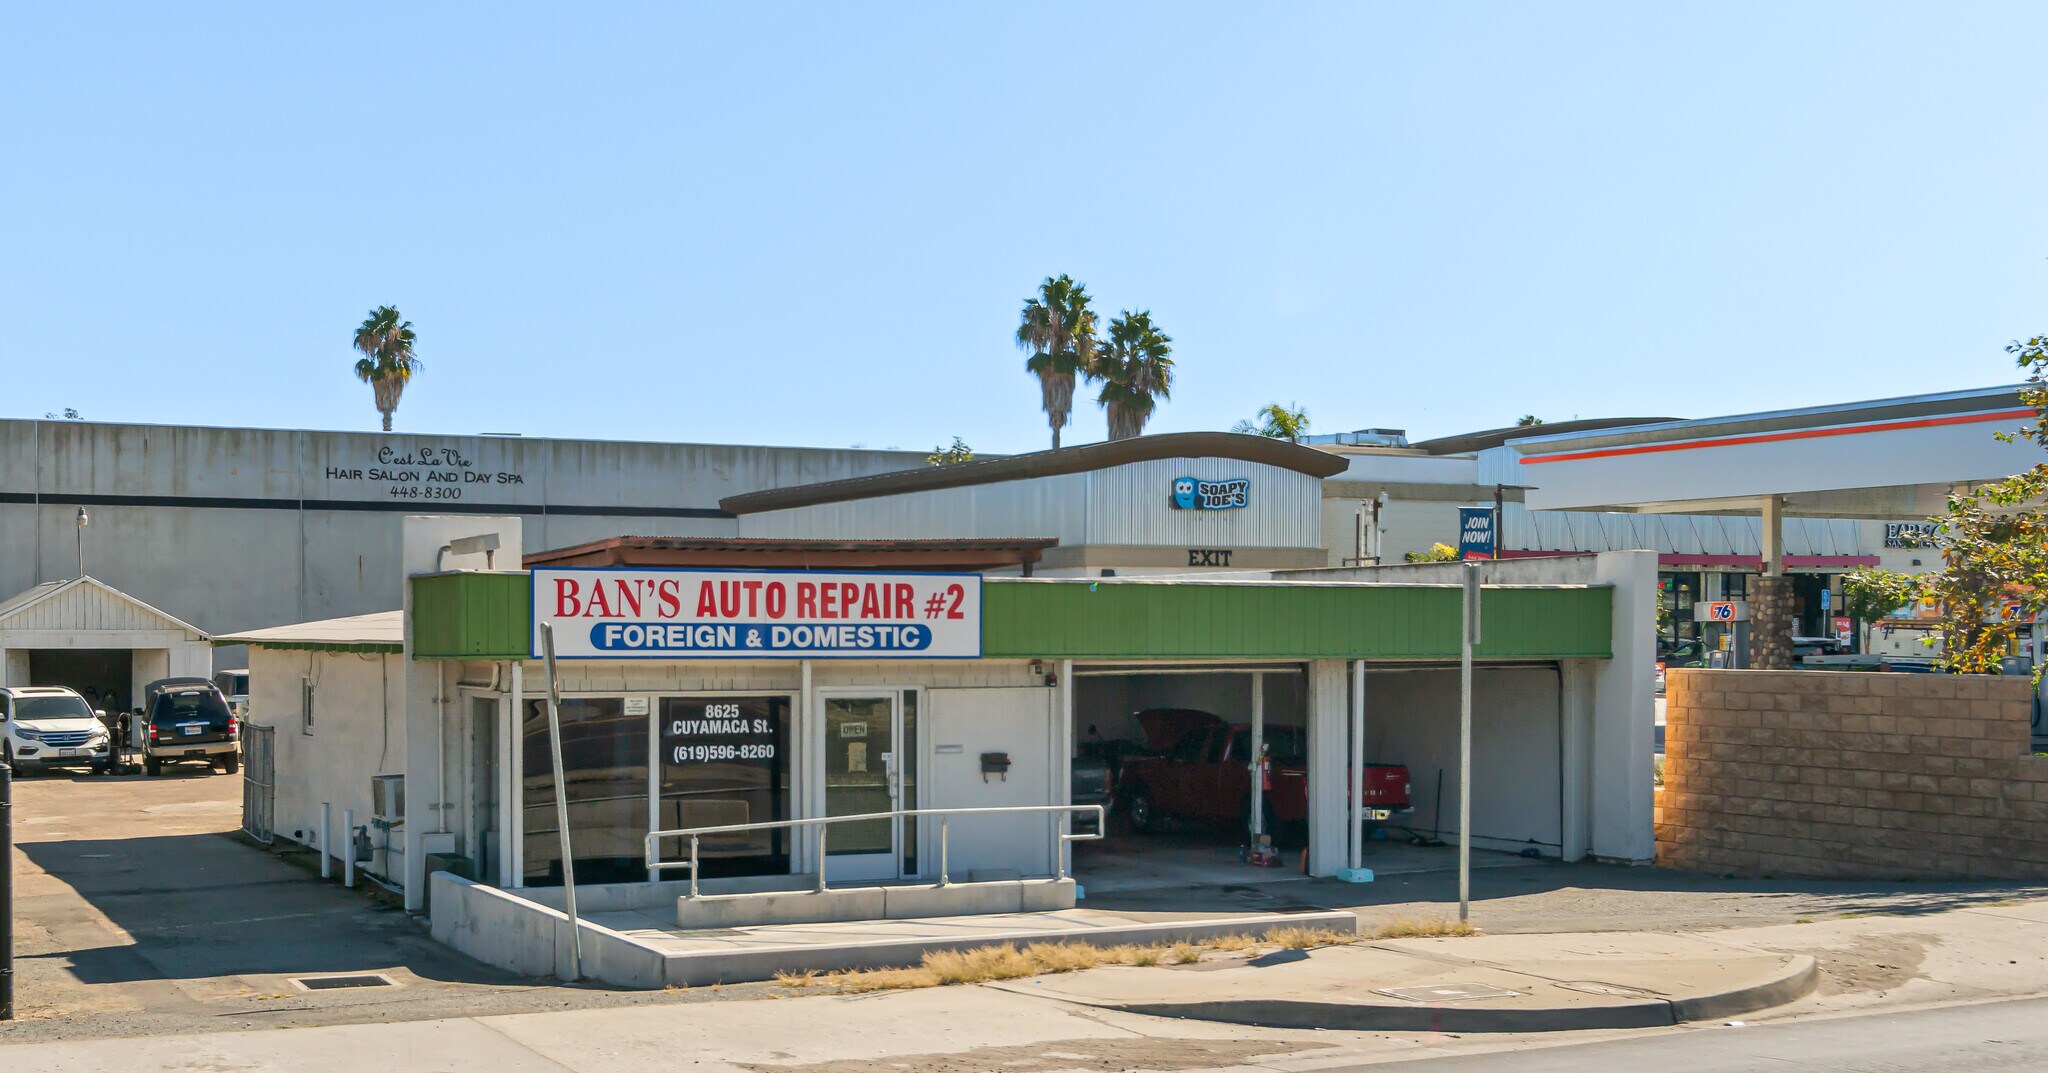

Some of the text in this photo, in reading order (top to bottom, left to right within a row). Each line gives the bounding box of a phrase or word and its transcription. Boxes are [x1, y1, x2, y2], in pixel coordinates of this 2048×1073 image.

[378, 446, 473, 467] C'est La Vie
[389, 485, 462, 500] 448-8300
[1200, 481, 1247, 496] SOAPY
[1204, 493, 1245, 507] JOE'S
[1465, 517, 1489, 529] JOIN
[1462, 530, 1492, 543] NOW!
[1188, 548, 1232, 567] EXIT
[553, 578, 964, 620] BAN'S AUTO REPAIR #2
[1713, 604, 1733, 619] 76
[605, 624, 920, 648] FOREIGN & DOMESTIC
[705, 704, 740, 719] 8625
[672, 718, 774, 735] CUYAMACA St.
[673, 744, 775, 763] (619)596-8260
